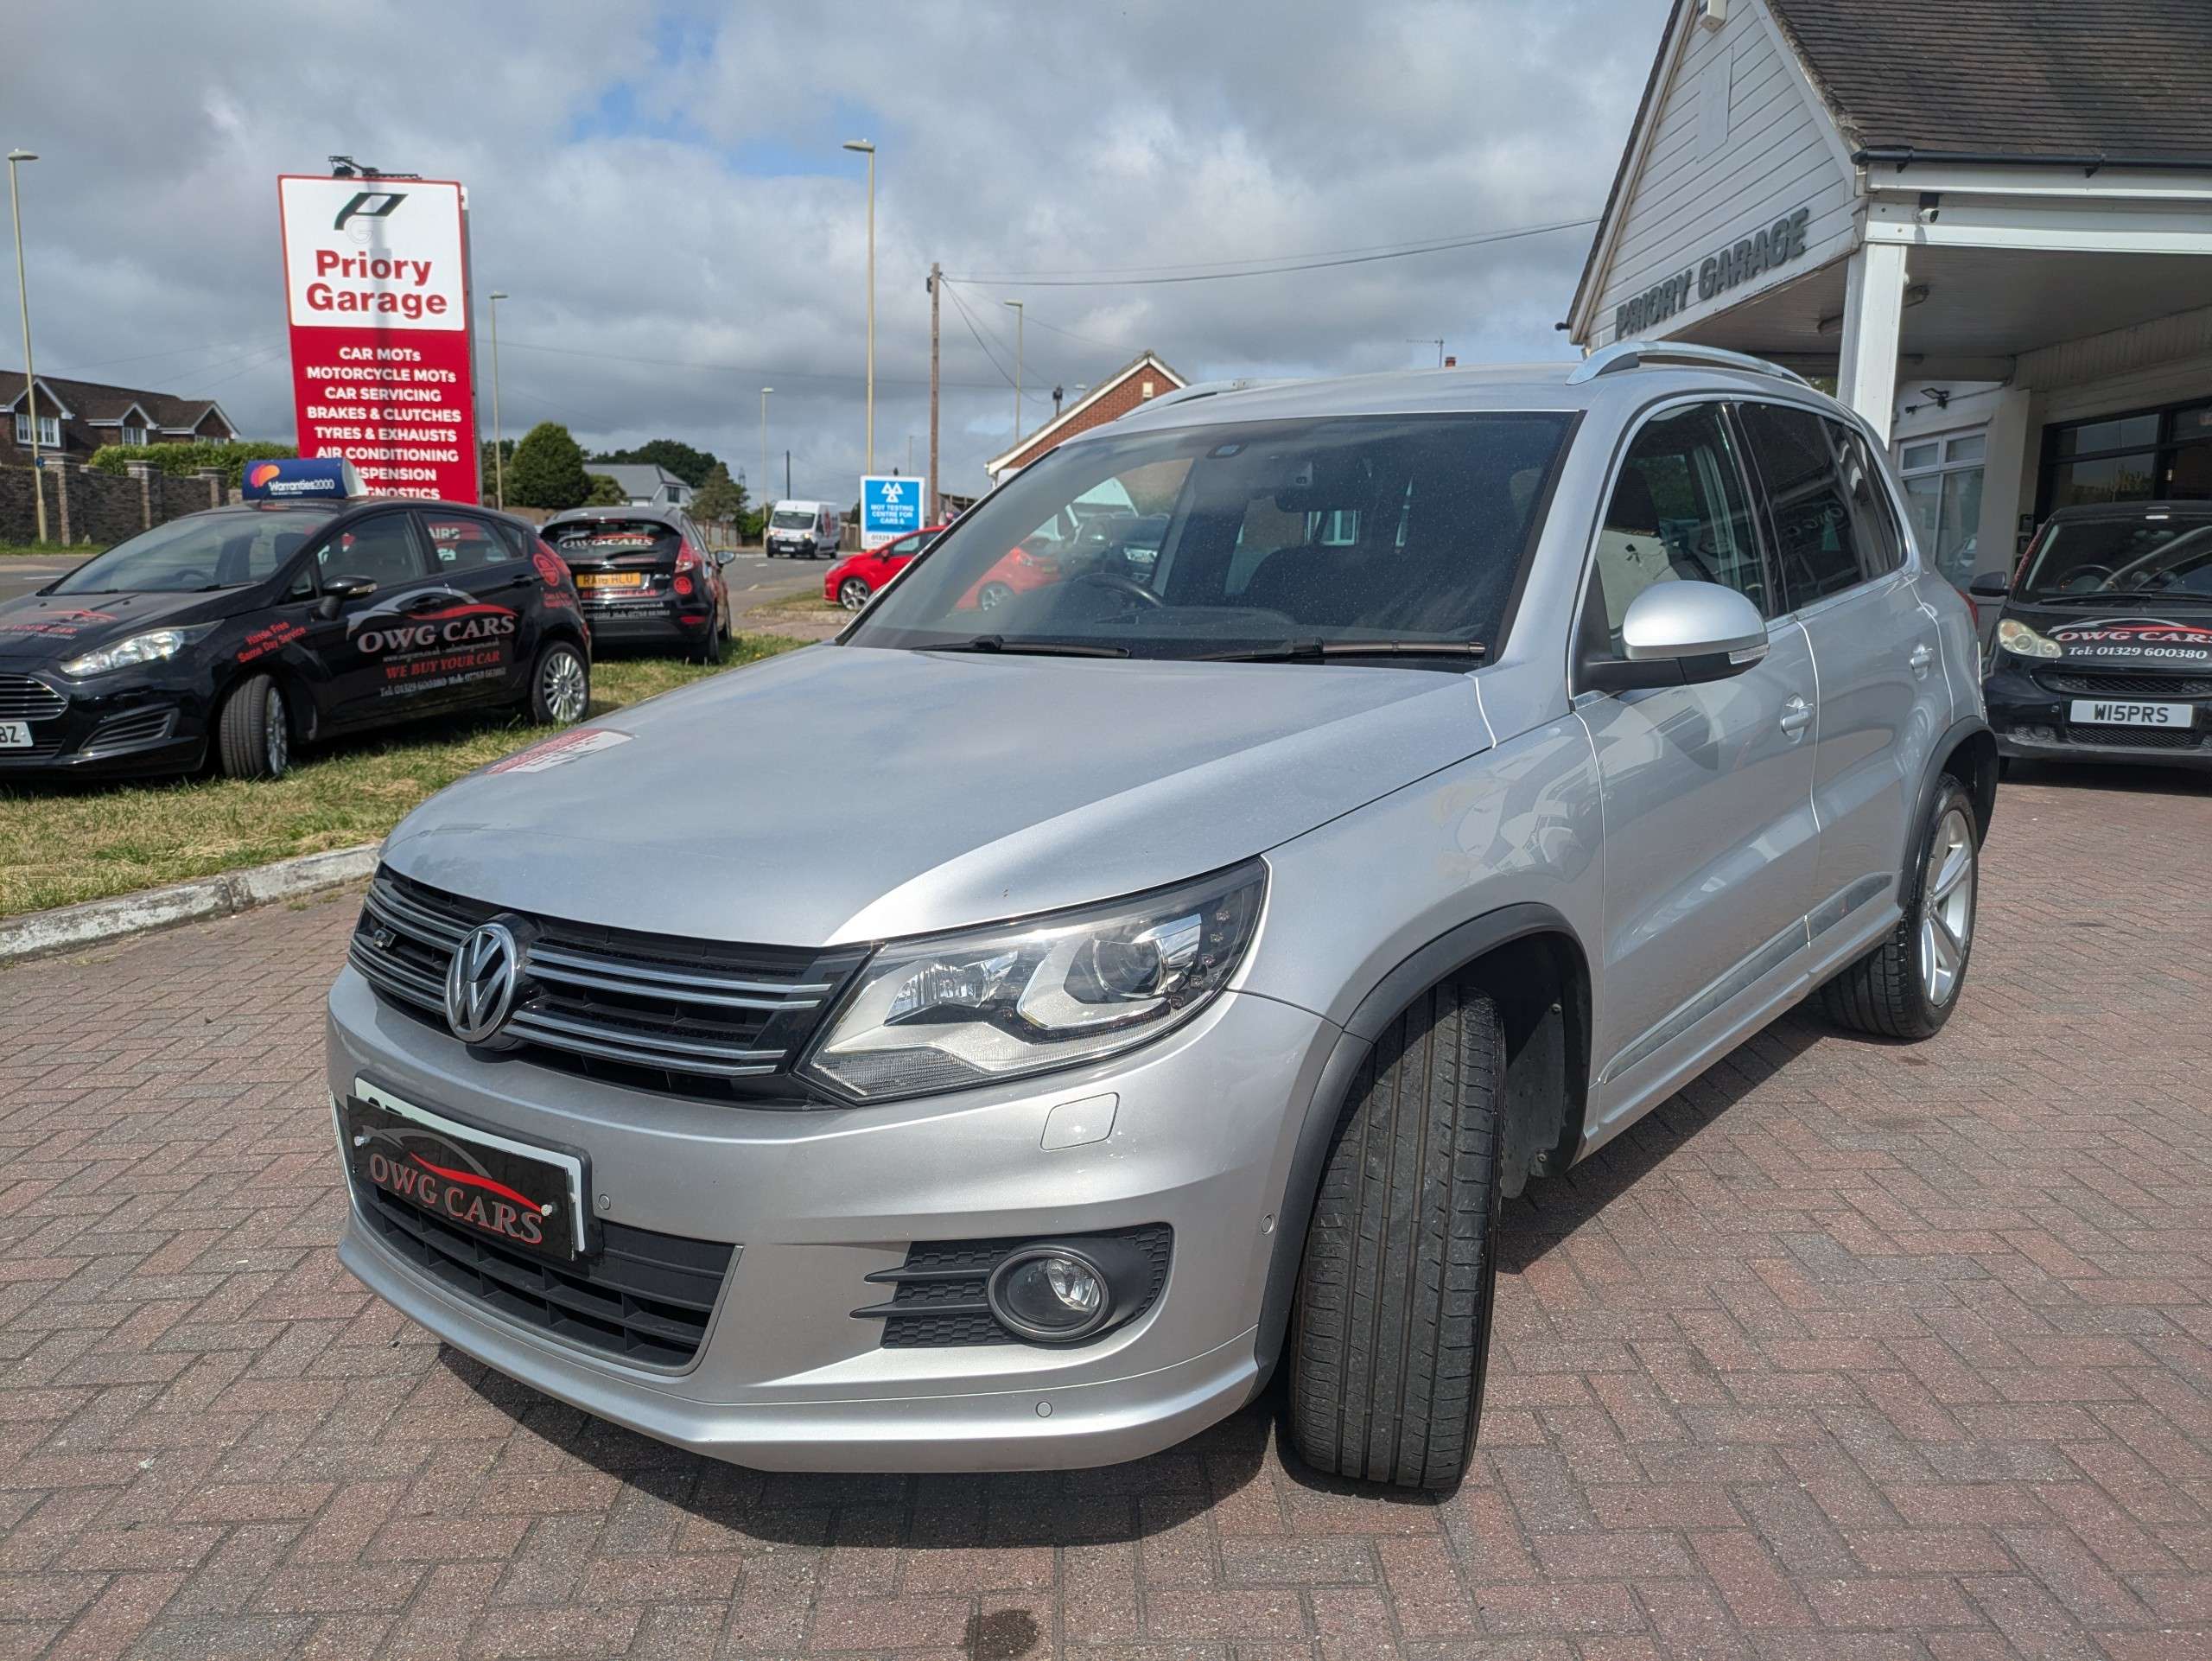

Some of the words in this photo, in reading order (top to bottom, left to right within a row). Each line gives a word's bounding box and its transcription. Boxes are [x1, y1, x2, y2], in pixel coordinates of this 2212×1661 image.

[315, 250, 432, 286] Priory
[1615, 269, 1692, 341] PRIORY
[1698, 207, 1809, 301] GARAGE
[306, 283, 448, 320] Garage
[340, 347, 372, 360] CAR
[377, 348, 421, 361] MOTs
[306, 366, 410, 381] MOTORCYCLE
[414, 369, 456, 383] MOTs
[325, 387, 357, 400] CAR
[359, 388, 442, 402] SERVICING
[307, 406, 366, 420] BRAKES
[370, 408, 380, 421] &
[383, 408, 462, 423] CLUTCHES
[315, 426, 362, 441] TYRES
[365, 428, 375, 441] &
[378, 429, 458, 442] EXHAUSTS
[316, 446, 342, 459] AIR
[346, 447, 459, 462] CONDITIONING
[356, 468, 436, 481] SPENSION
[367, 487, 440, 500] GNOSTICS
[607, 538, 655, 547] CARS
[357, 625, 436, 653] OWG
[442, 615, 516, 642] CARS
[2054, 631, 2132, 642] OWG
[2069, 646, 2093, 656] Tel:
[2096, 646, 2141, 657] 01329
[2144, 647, 2208, 659] 600380
[386, 665, 407, 679] WE
[410, 660, 439, 675] BUY
[440, 653, 475, 671] YOUR
[477, 651, 500, 665] CAR
[369, 1152, 437, 1204] OWG
[443, 1185, 544, 1244] CARS
